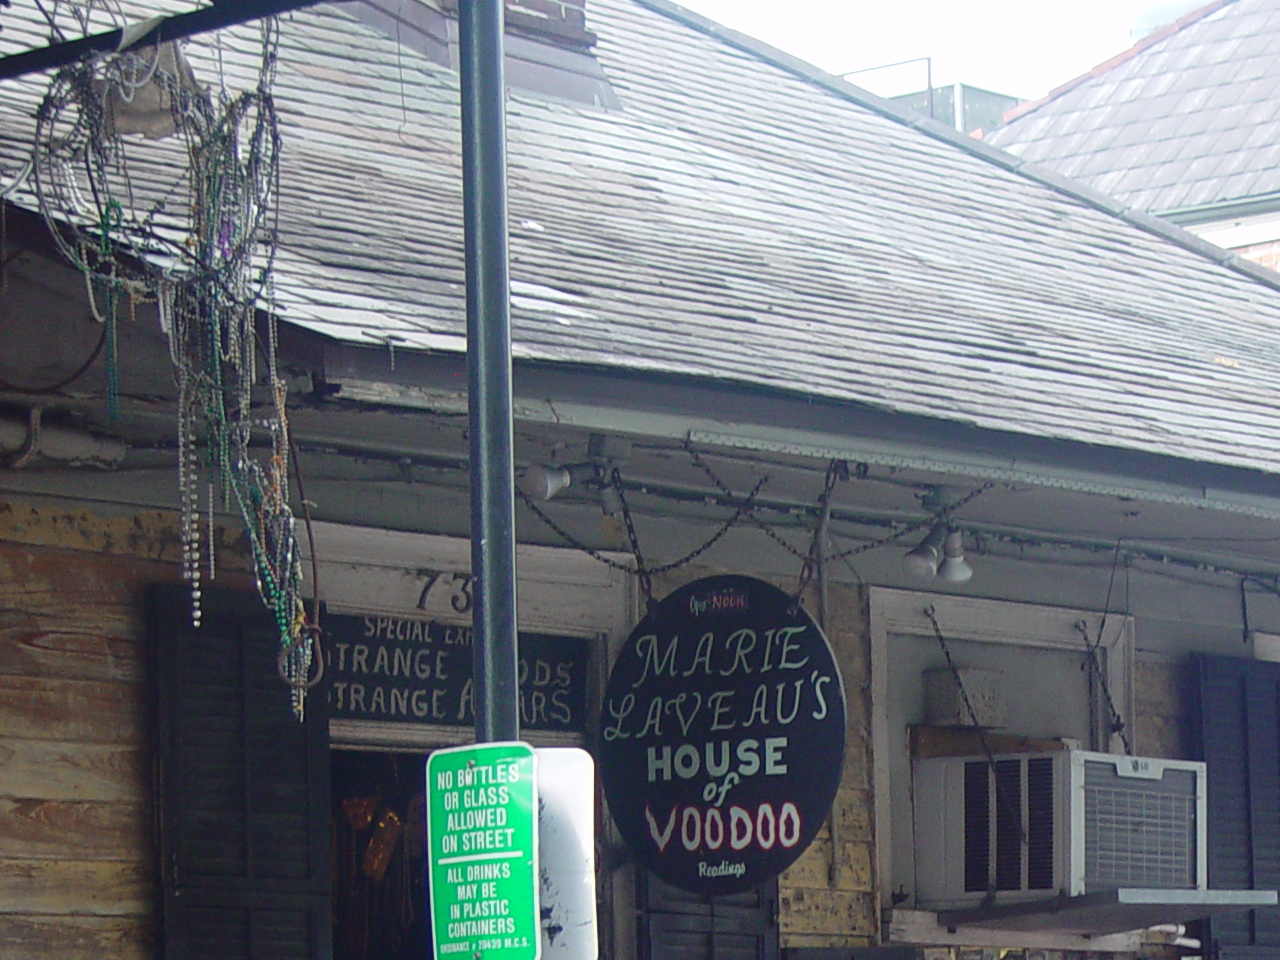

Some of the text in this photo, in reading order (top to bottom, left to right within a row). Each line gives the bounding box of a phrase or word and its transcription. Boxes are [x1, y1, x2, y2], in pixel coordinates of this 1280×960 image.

[415, 570, 473, 613] 73
[364, 617, 433, 643] SPECIAL
[327, 643, 449, 680] TRANGE
[632, 625, 809, 688] MARIE
[327, 682, 448, 719] TRANGE
[604, 670, 831, 740] LAVEAU'S
[647, 736, 788, 782] HOUSE
[437, 763, 520, 790] NO BOTTLES
[702, 771, 741, 807] of
[444, 786, 510, 811] OR GLASS
[447, 807, 507, 831] ALLOWED
[645, 801, 801, 853] VOODOO
[442, 828, 515, 853] ON STREET
[447, 862, 511, 883] ALL DRINKS
[698, 860, 746, 878] Readings
[457, 882, 497, 901] MAY BE
[450, 899, 510, 919] IN PLASTIC
[447, 917, 515, 938] CONTAINERS
